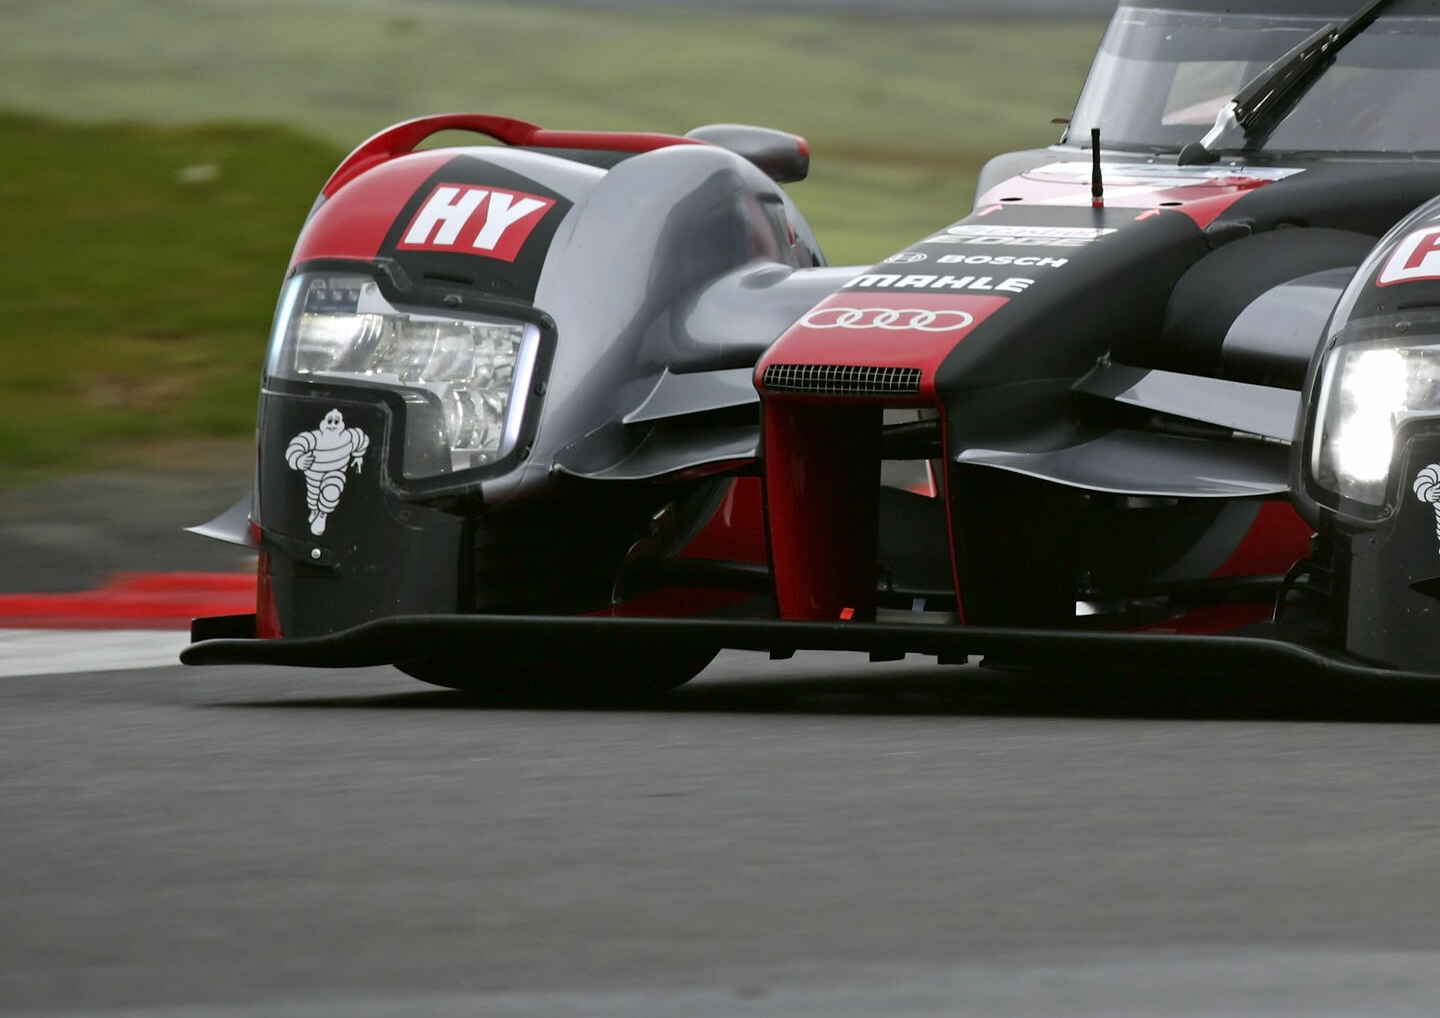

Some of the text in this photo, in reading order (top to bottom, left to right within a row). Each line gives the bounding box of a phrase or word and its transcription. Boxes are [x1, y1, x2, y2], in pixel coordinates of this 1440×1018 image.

[404, 187, 547, 250] HY
[936, 254, 1068, 268] BOSCH
[843, 273, 1035, 293] MAHLE
